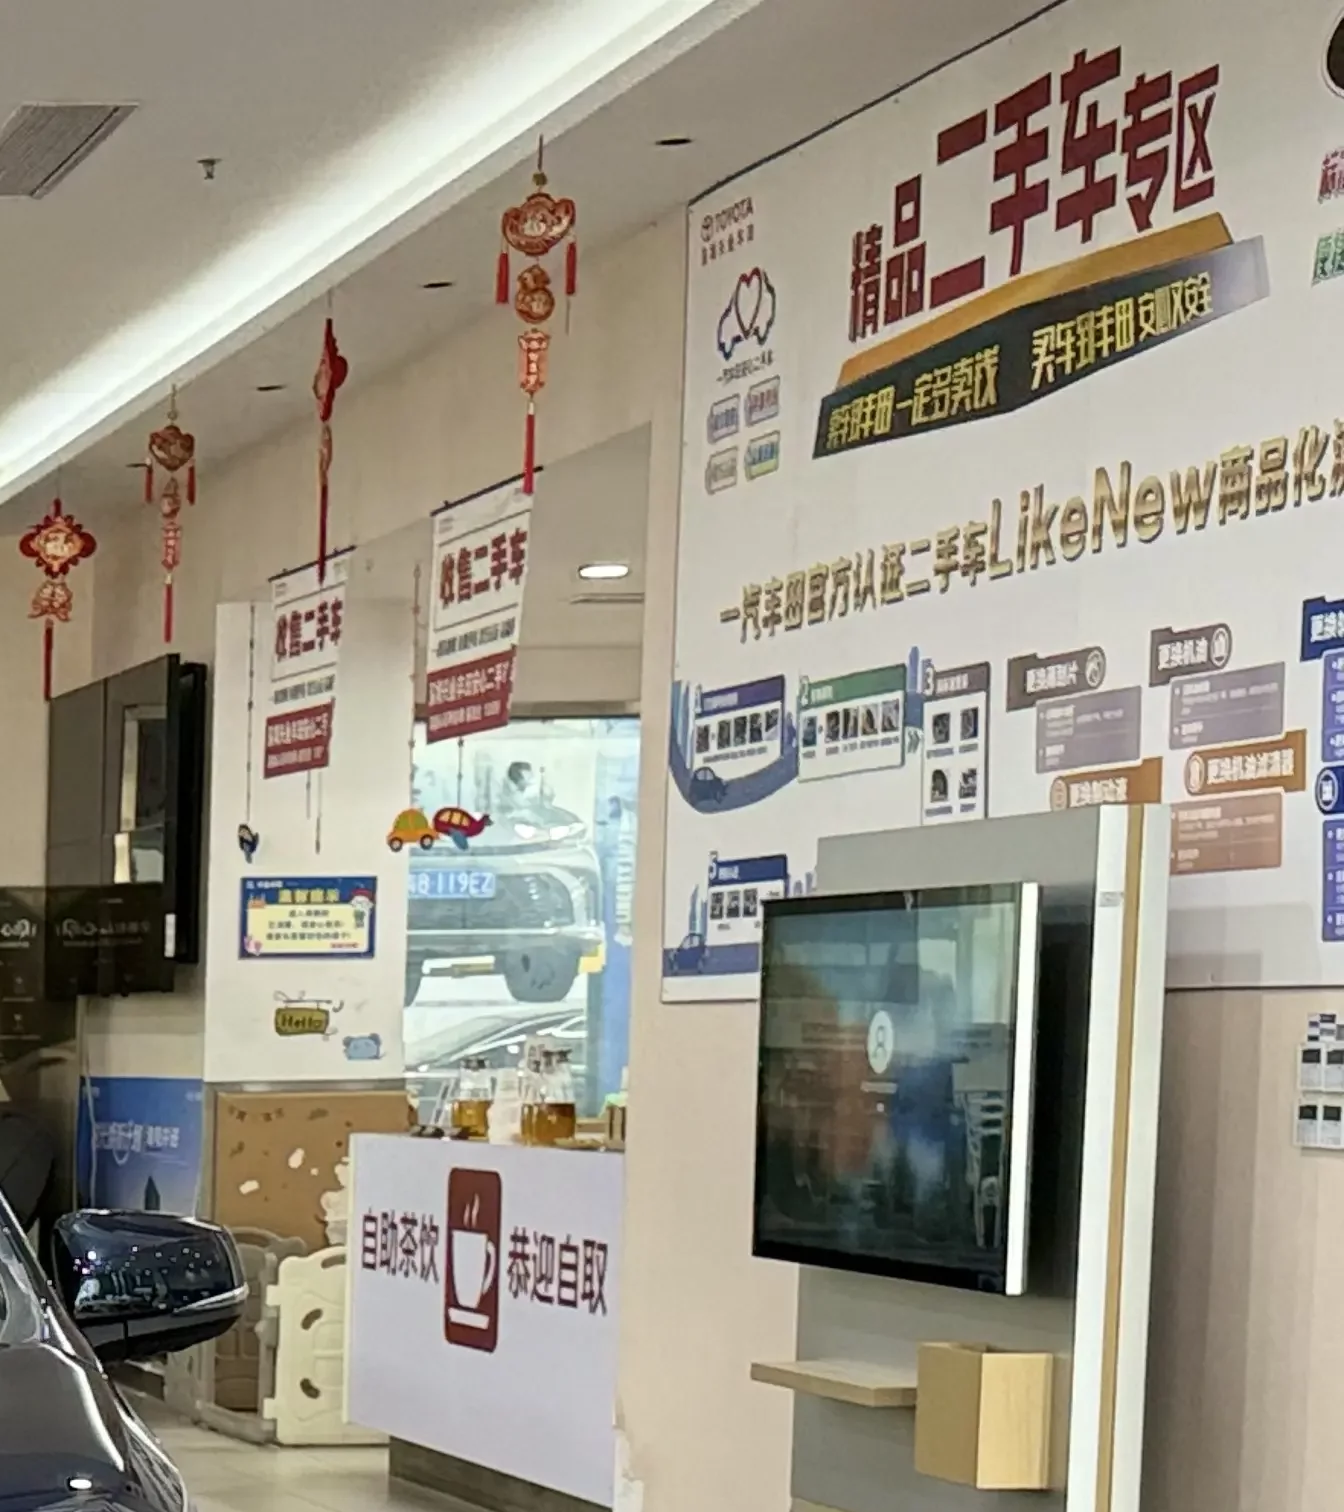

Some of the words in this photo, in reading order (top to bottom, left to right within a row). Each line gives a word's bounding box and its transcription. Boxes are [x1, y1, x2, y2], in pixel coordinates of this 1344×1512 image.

[848, 46, 1220, 342] 精品二手车专区
[361, 1207, 440, 1285] 自助茶饮
[506, 1223, 609, 1317] 恭迎自取
